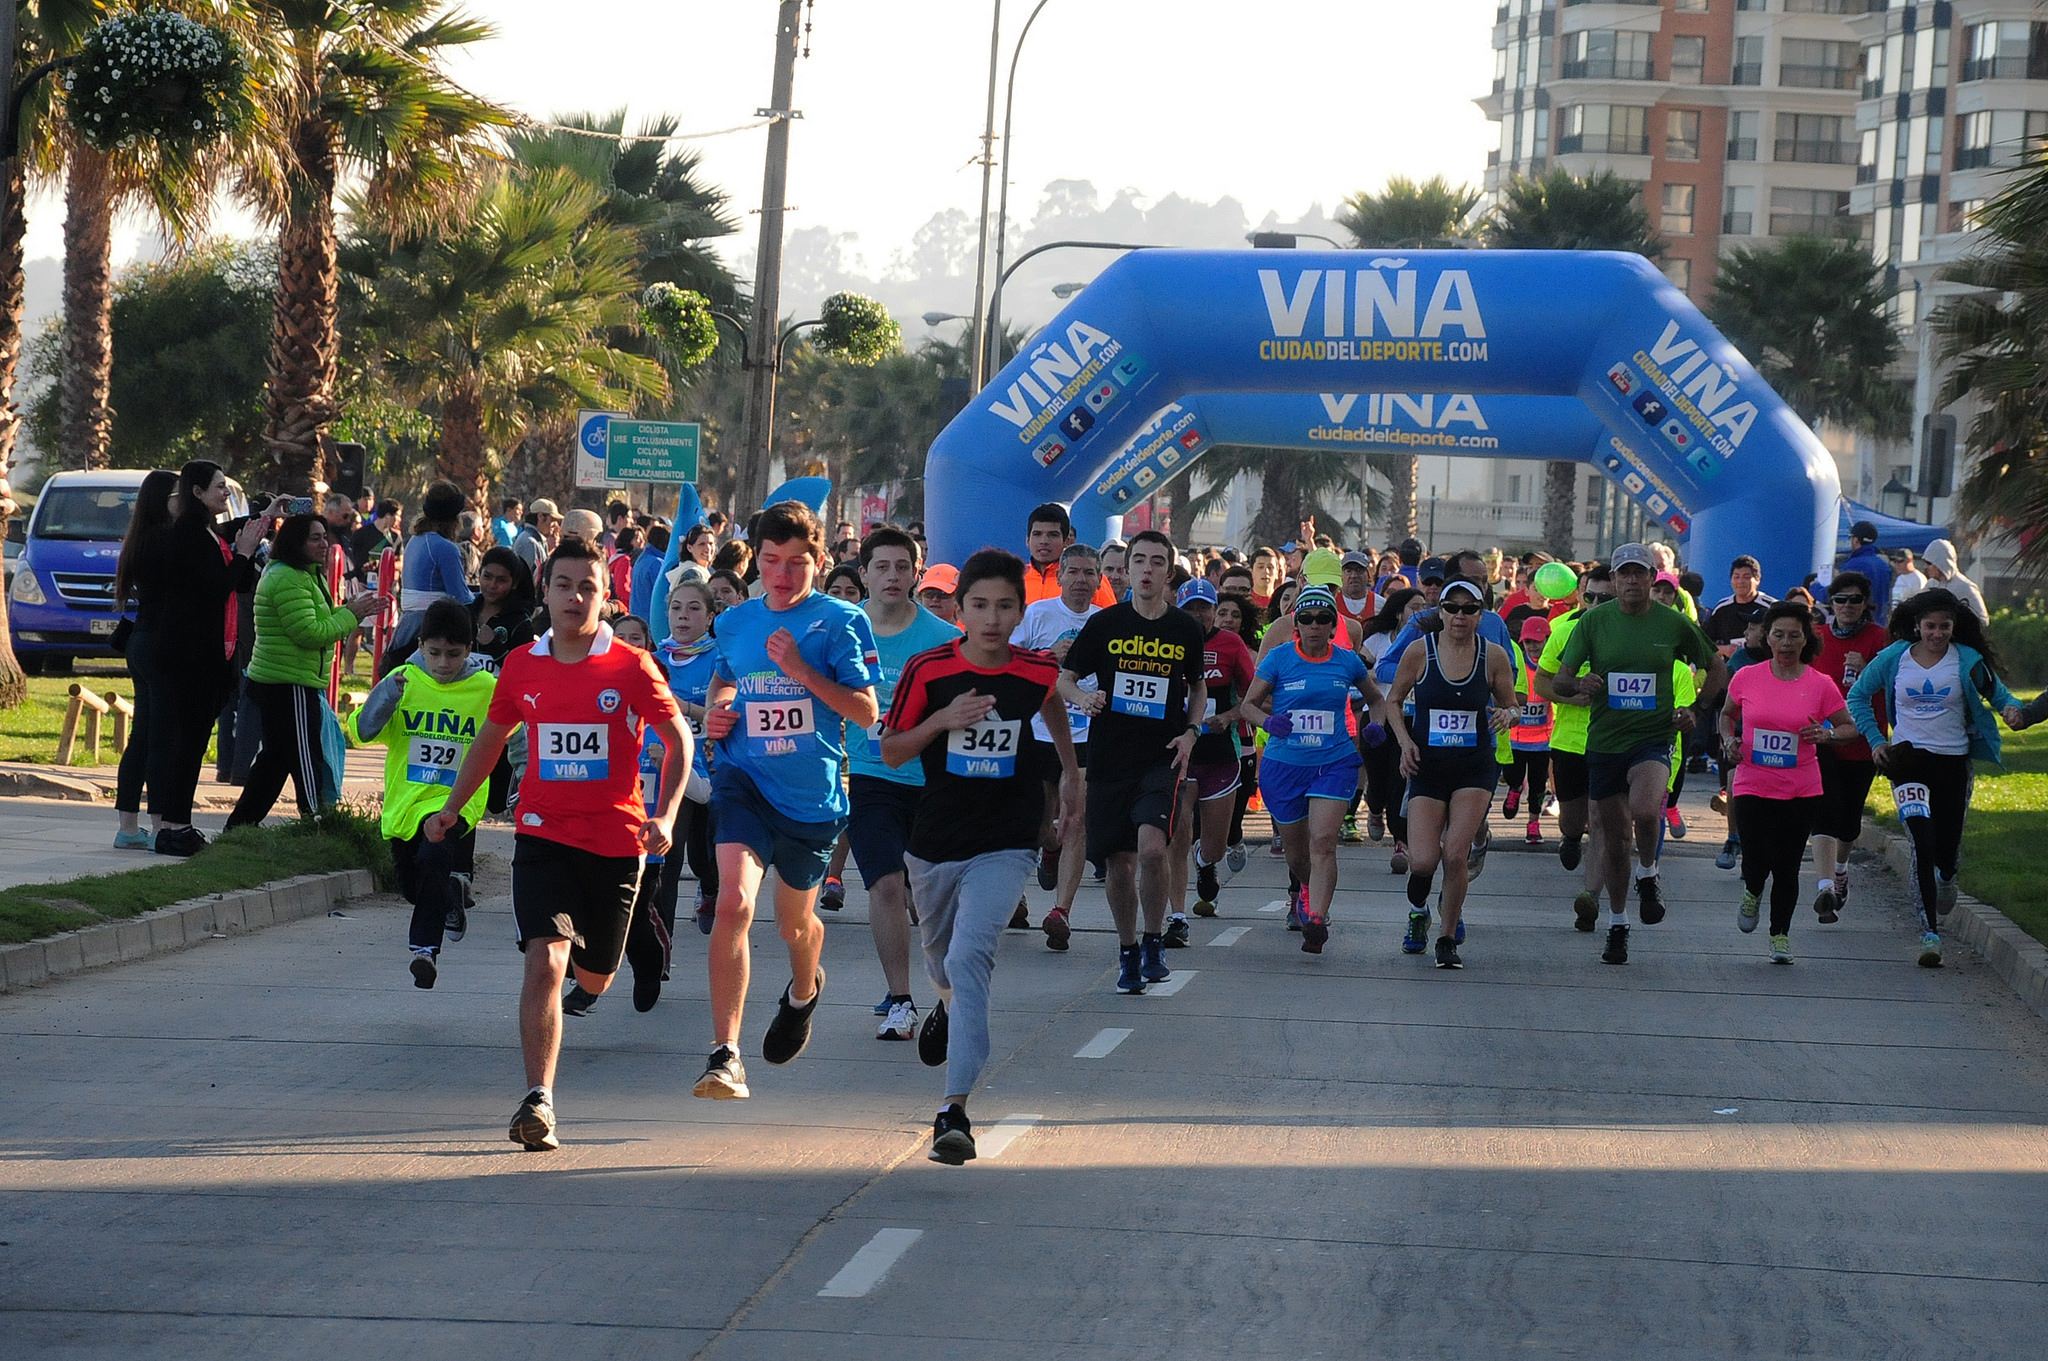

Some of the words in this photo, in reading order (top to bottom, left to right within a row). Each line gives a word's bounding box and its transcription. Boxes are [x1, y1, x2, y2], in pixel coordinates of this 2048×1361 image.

[1257, 257, 1487, 338] VIÑA
[1259, 340, 1489, 362] CIUDADDELDEPORTE.COM
[989, 320, 1111, 428] VIÑA
[1650, 318, 1759, 448] VIÑA
[1018, 339, 1123, 445] CIUDADDELDEPORTE.COM
[1633, 350, 1735, 459] CIUDADDELDEPORTE.COM
[613, 434, 628, 443] USE
[632, 436, 693, 447] EXCLUSIVAMENTE
[1308, 425, 1499, 449] ciudaddeldeporte.com
[636, 447, 669, 456] CICLOVIA
[1096, 411, 1196, 496] ciudaddeldeporte.com
[632, 458, 651, 466] PARA
[658, 459, 672, 468] SUS
[618, 468, 685, 479] DESPLAZAMIENTOS
[1107, 635, 1185, 660] adidas
[1118, 657, 1171, 676] training
[1124, 679, 1157, 699] 315
[1617, 678, 1651, 693] 047
[1126, 701, 1150, 713] VIÑA
[1522, 704, 1544, 715] 302
[1620, 698, 1643, 708] VIÑA
[403, 708, 476, 737] VIÑA
[758, 708, 803, 731] 320
[1299, 714, 1324, 730] 111
[1438, 714, 1469, 730] 037
[550, 731, 600, 754] 304
[764, 738, 797, 752] VIÑA
[962, 729, 1012, 752] 342
[1300, 735, 1321, 745] VIÑA
[1442, 735, 1464, 744] VIÑA
[1762, 734, 1791, 751] 102
[420, 744, 456, 765] 329
[1763, 754, 1783, 764] VIÑA
[554, 762, 589, 777] VIÑA
[966, 759, 999, 773] VIÑA
